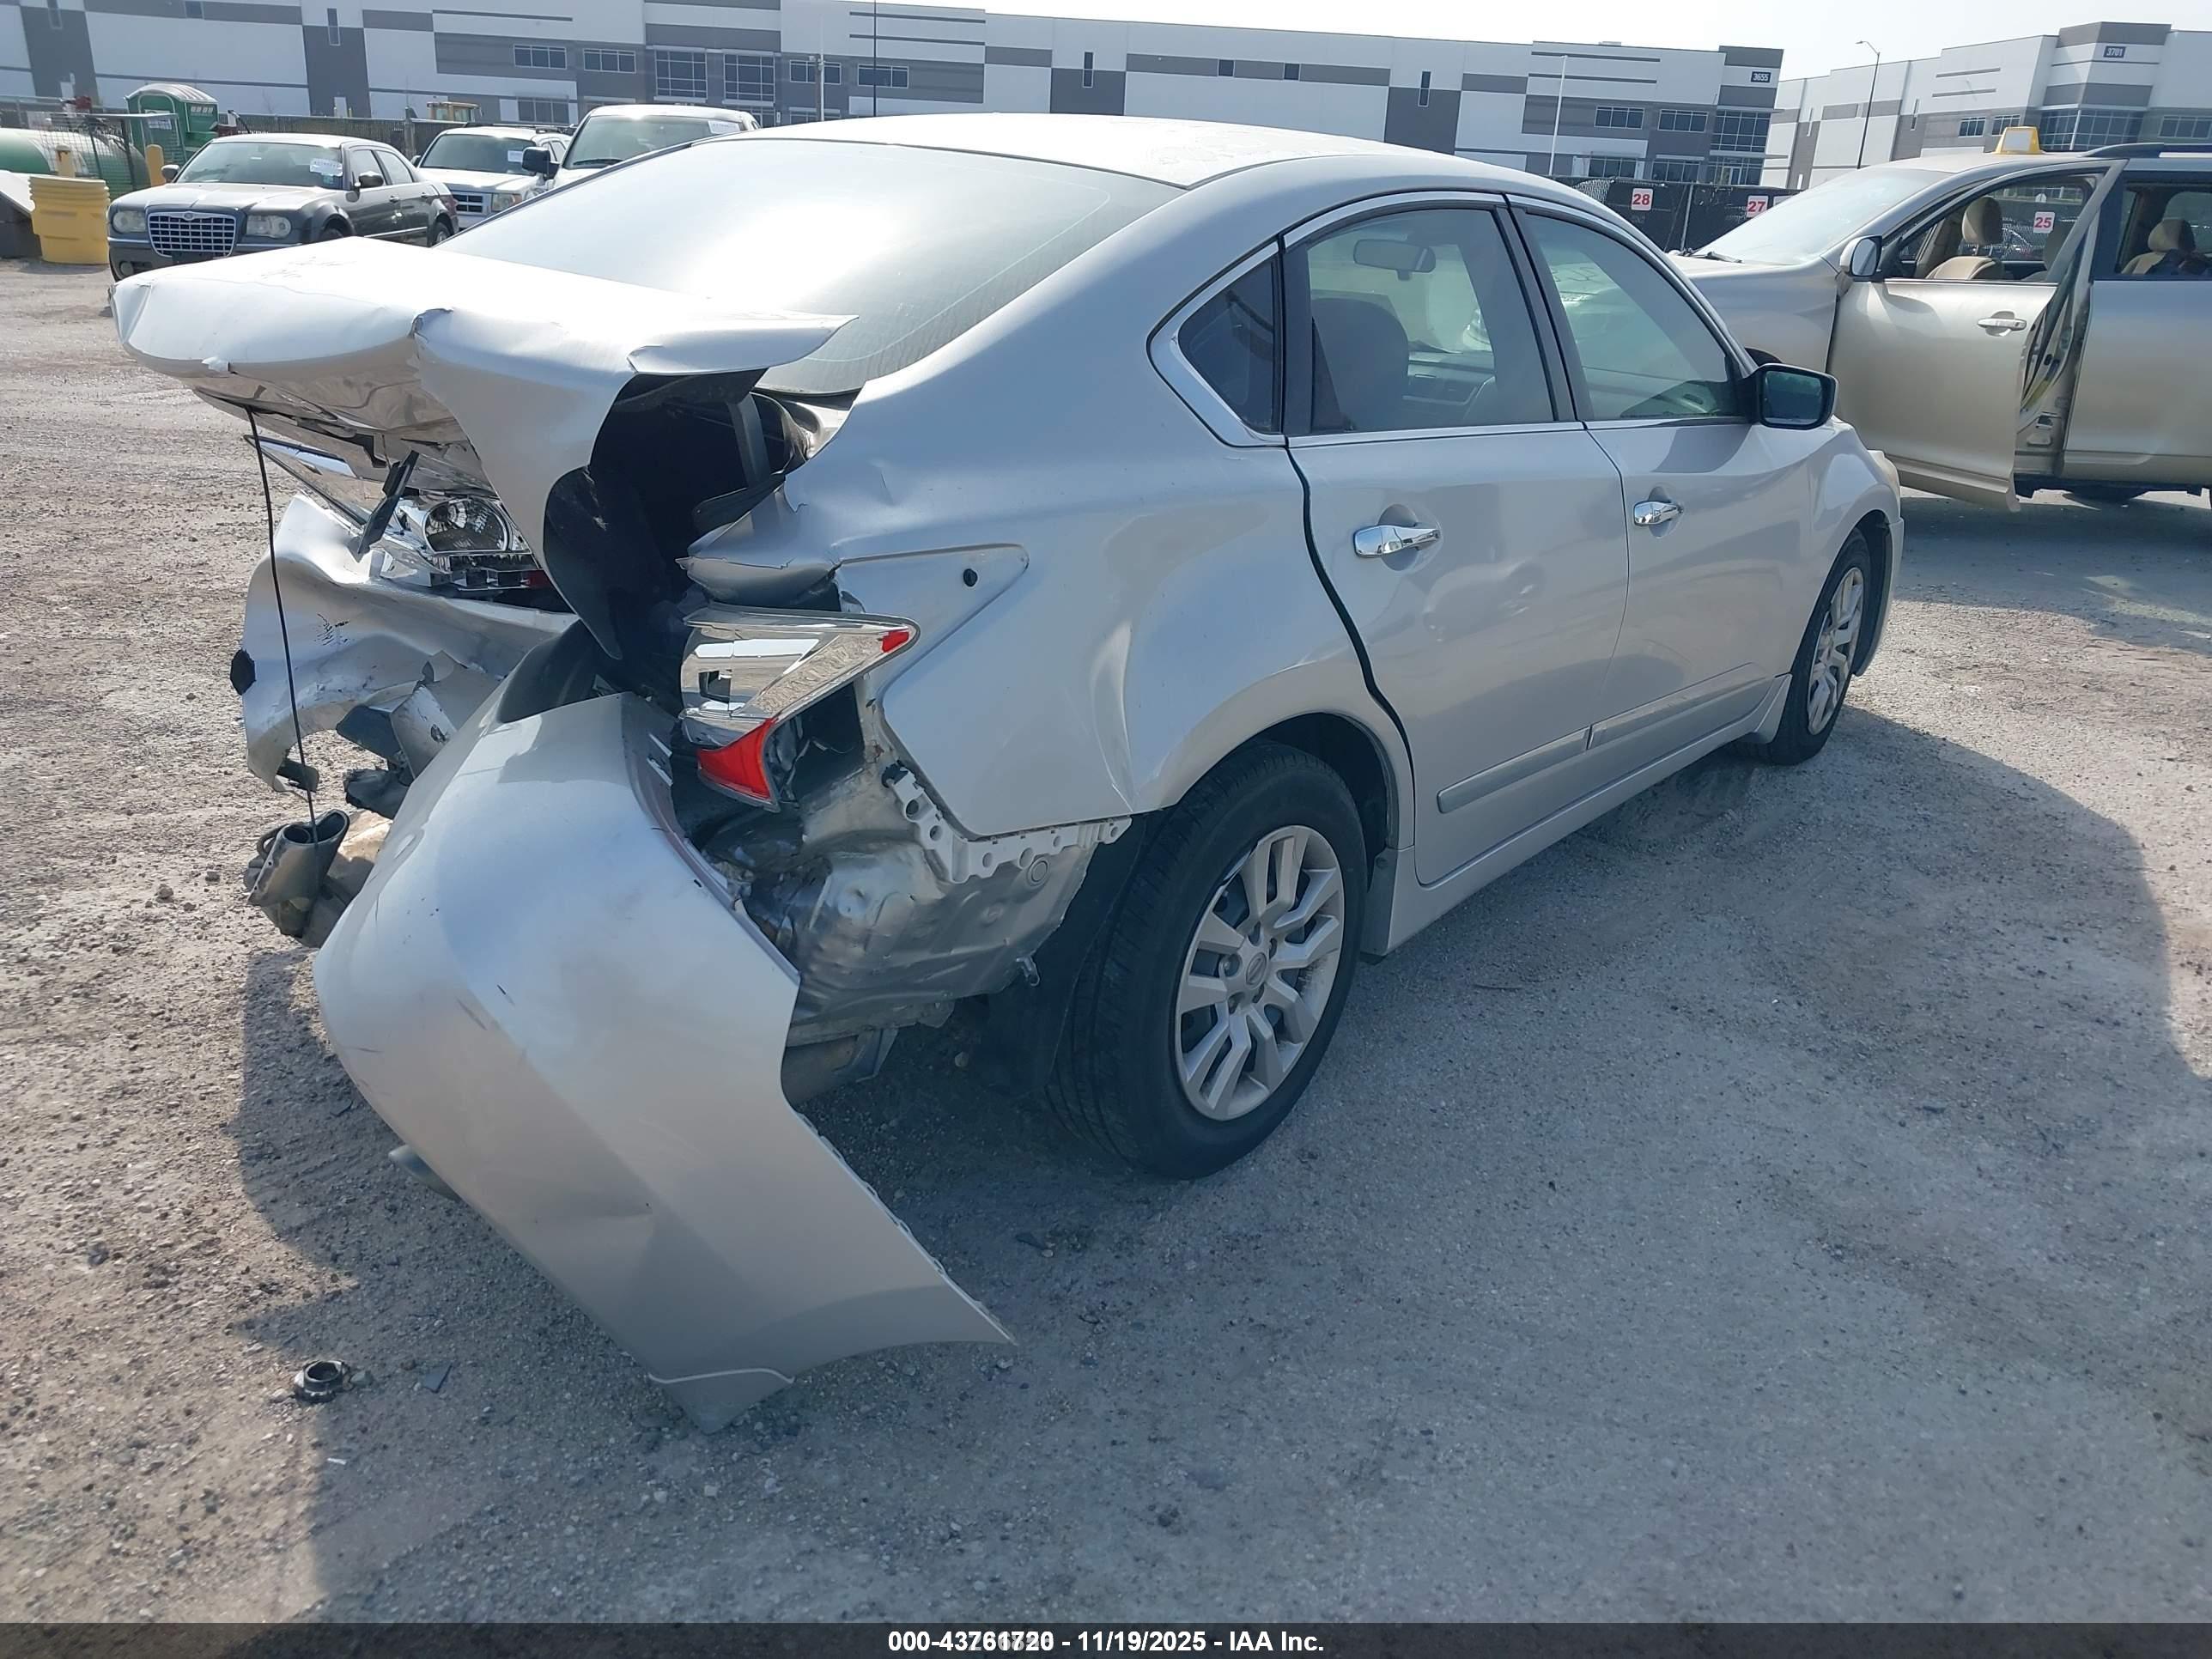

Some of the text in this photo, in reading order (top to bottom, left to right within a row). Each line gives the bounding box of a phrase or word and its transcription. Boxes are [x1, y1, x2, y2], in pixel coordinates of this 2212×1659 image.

[2106, 47, 2124, 57] 3701
[1753, 73, 1770, 82] 3655
[1632, 193, 1650, 205] 28
[1747, 201, 1766, 212] 27
[2034, 216, 2052, 228] 25
